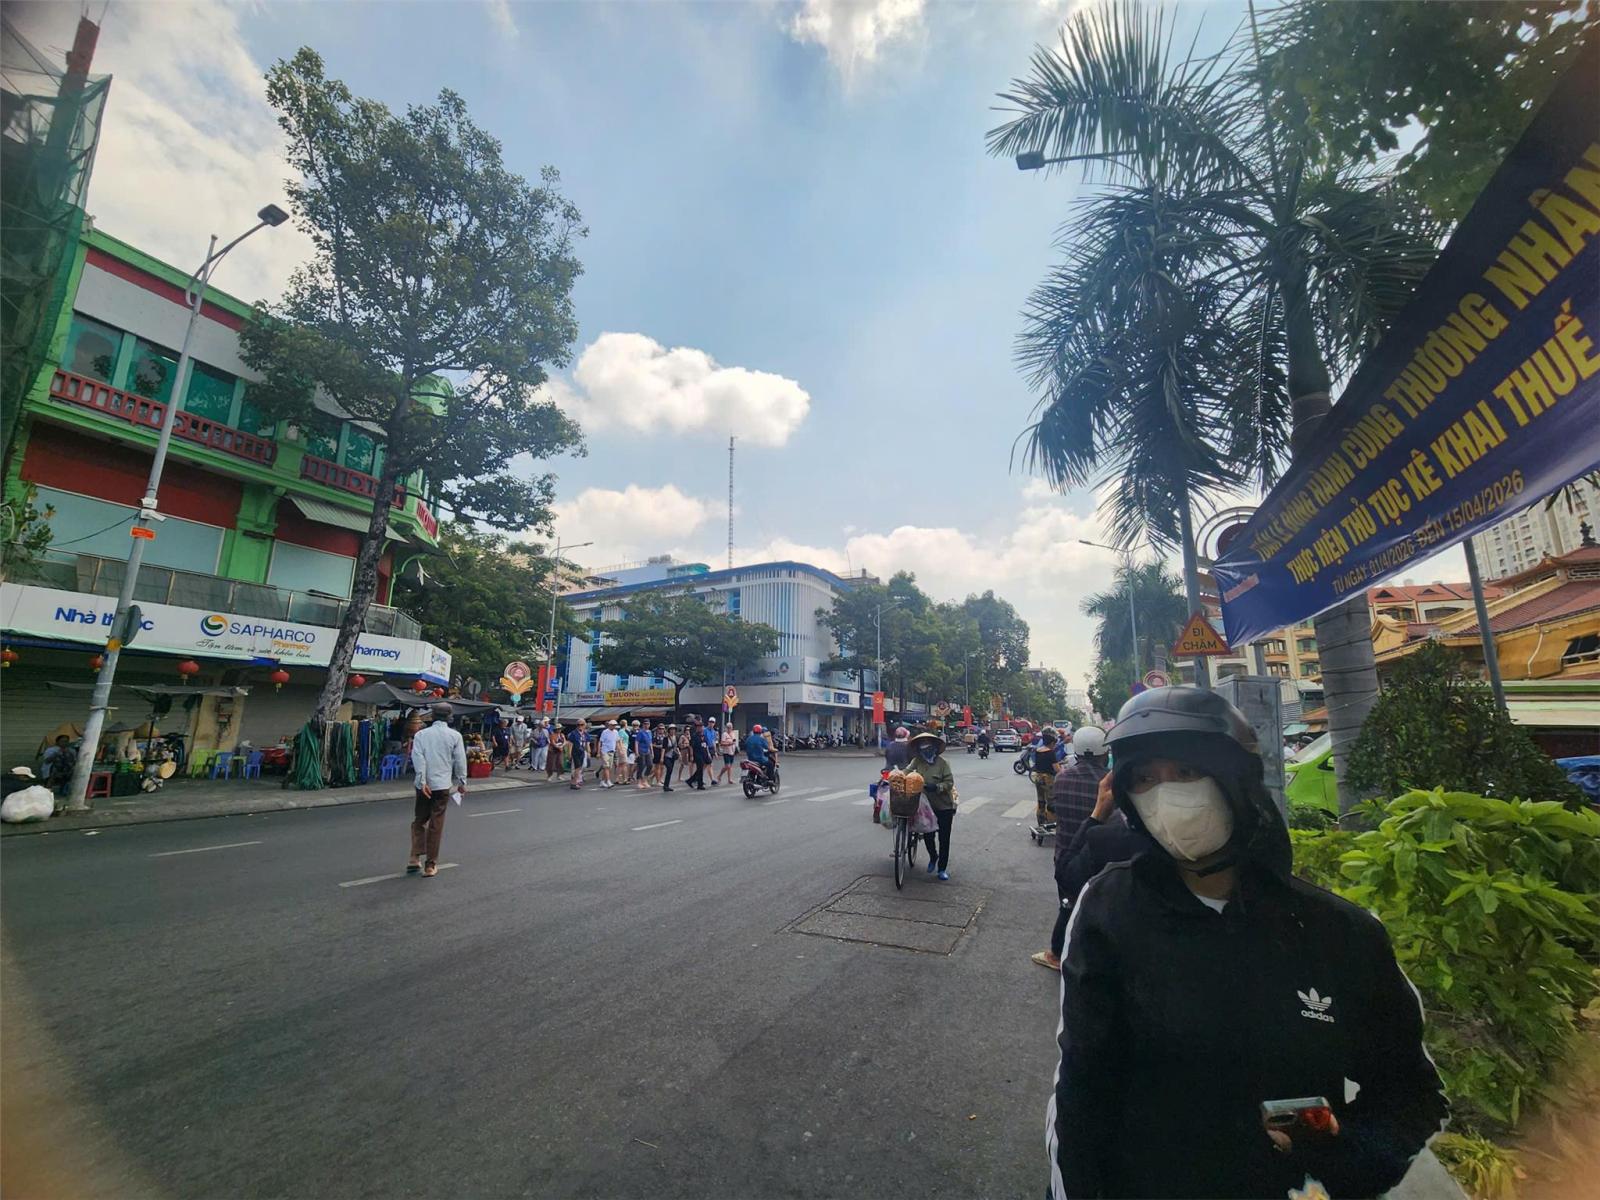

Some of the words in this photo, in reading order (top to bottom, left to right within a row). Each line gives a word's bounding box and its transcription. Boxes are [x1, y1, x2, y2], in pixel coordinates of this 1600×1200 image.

[1306, 451, 1355, 507] HÀNH
[1340, 403, 1405, 470] CÙNG
[1383, 292, 1510, 419] THƯƠNG
[1286, 547, 1320, 585] THỰC
[1312, 525, 1350, 567] HIỆN
[1340, 497, 1377, 546] THỦ
[1367, 478, 1412, 526] TỤC
[1400, 447, 1444, 502] KÊ
[1429, 399, 1508, 479] KHAI
[1492, 298, 1600, 427] THUẾ
[1415, 515, 1446, 547] ĐẾN
[1446, 469, 1524, 531] 15/04/2026
[55, 607, 97, 625] Nhà
[229, 622, 316, 644] SAPHARCO
[1192, 627, 1205, 637] ĐI
[272, 639, 312, 652] Pharmacy
[1300, 1009, 1335, 1023] adidas
